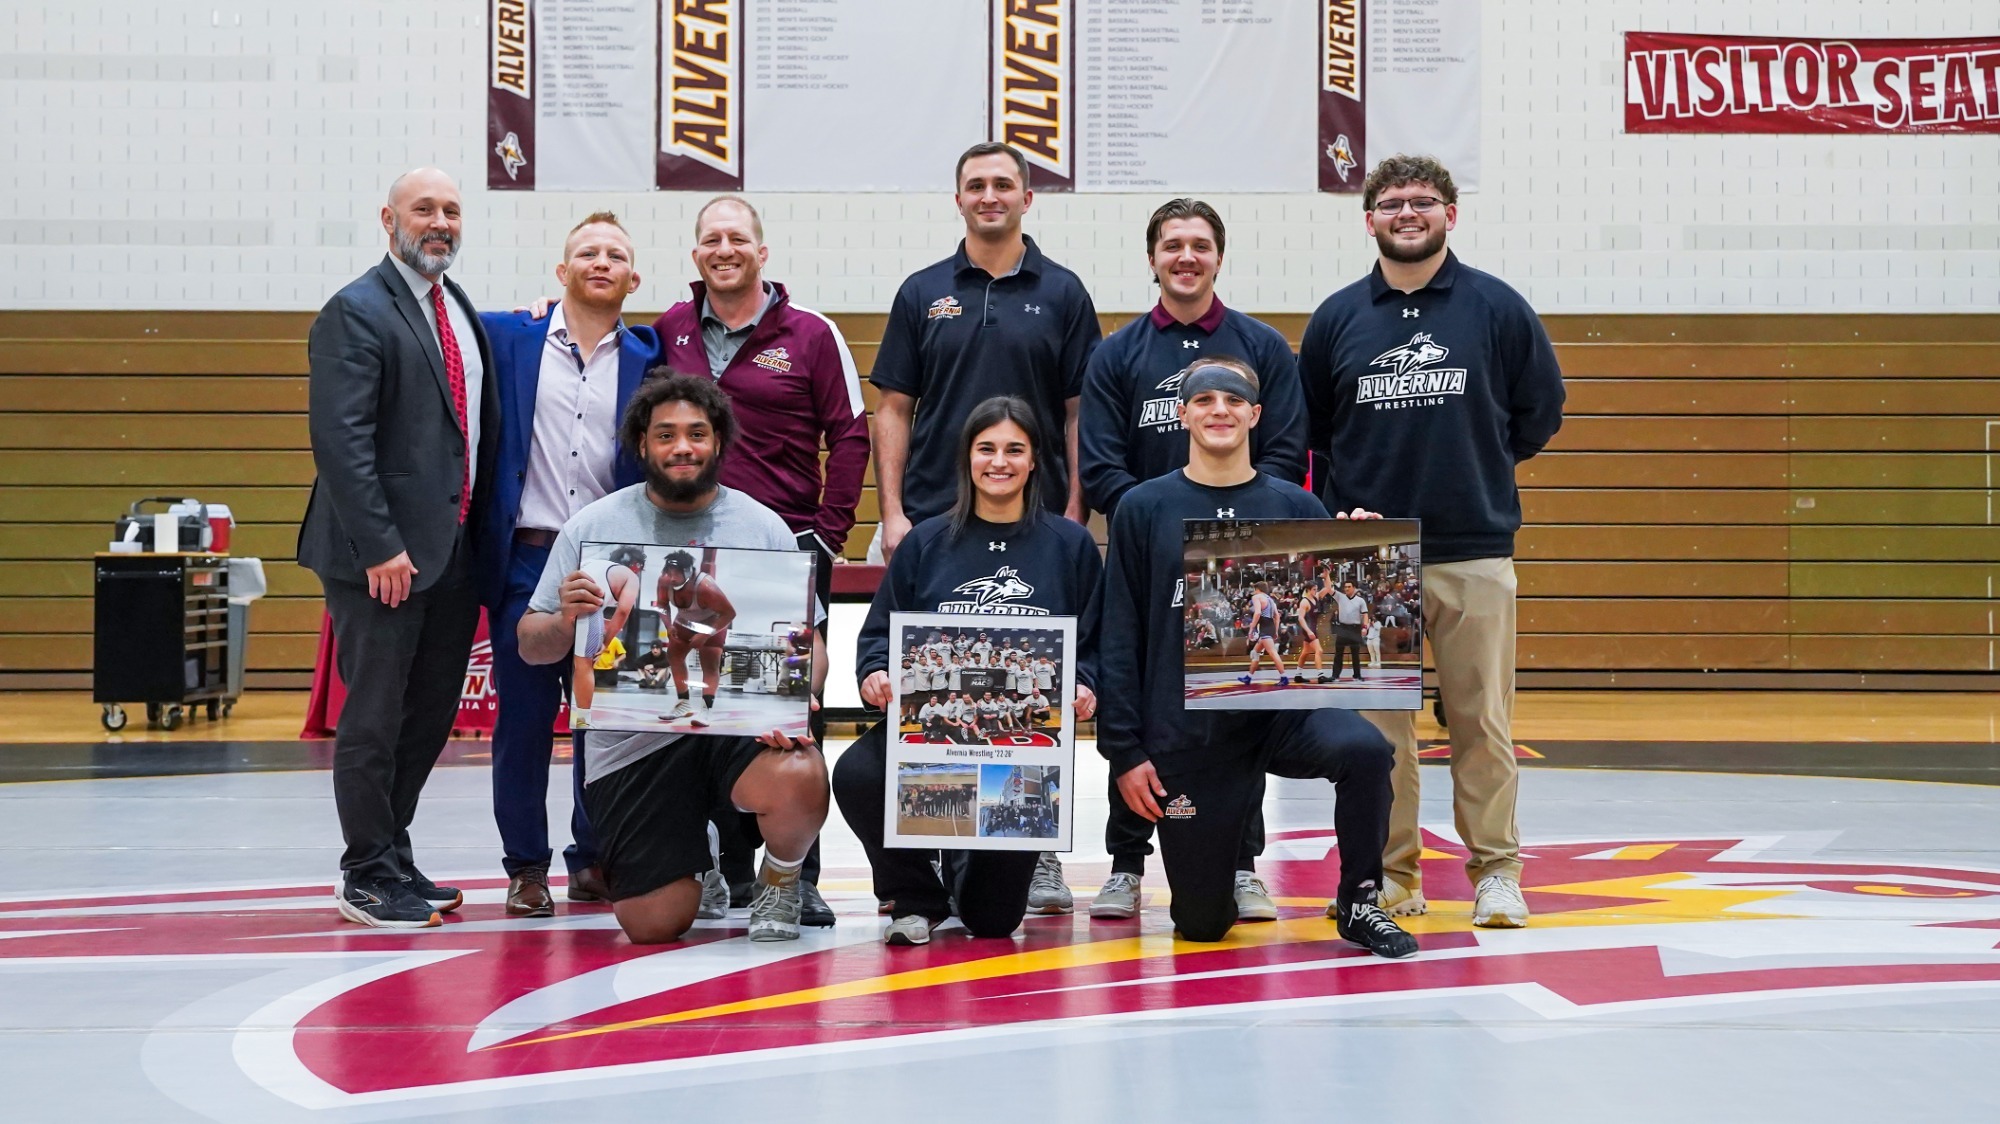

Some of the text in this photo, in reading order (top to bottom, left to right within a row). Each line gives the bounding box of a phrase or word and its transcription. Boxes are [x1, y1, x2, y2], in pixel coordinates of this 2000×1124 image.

[1631, 41, 1861, 120] VISITOR
[754, 355, 791, 371] ALVERNIA
[1358, 370, 1466, 402] ALVERNIA
[1374, 397, 1444, 411] WRESTLING
[969, 749, 993, 758] Wrestling
